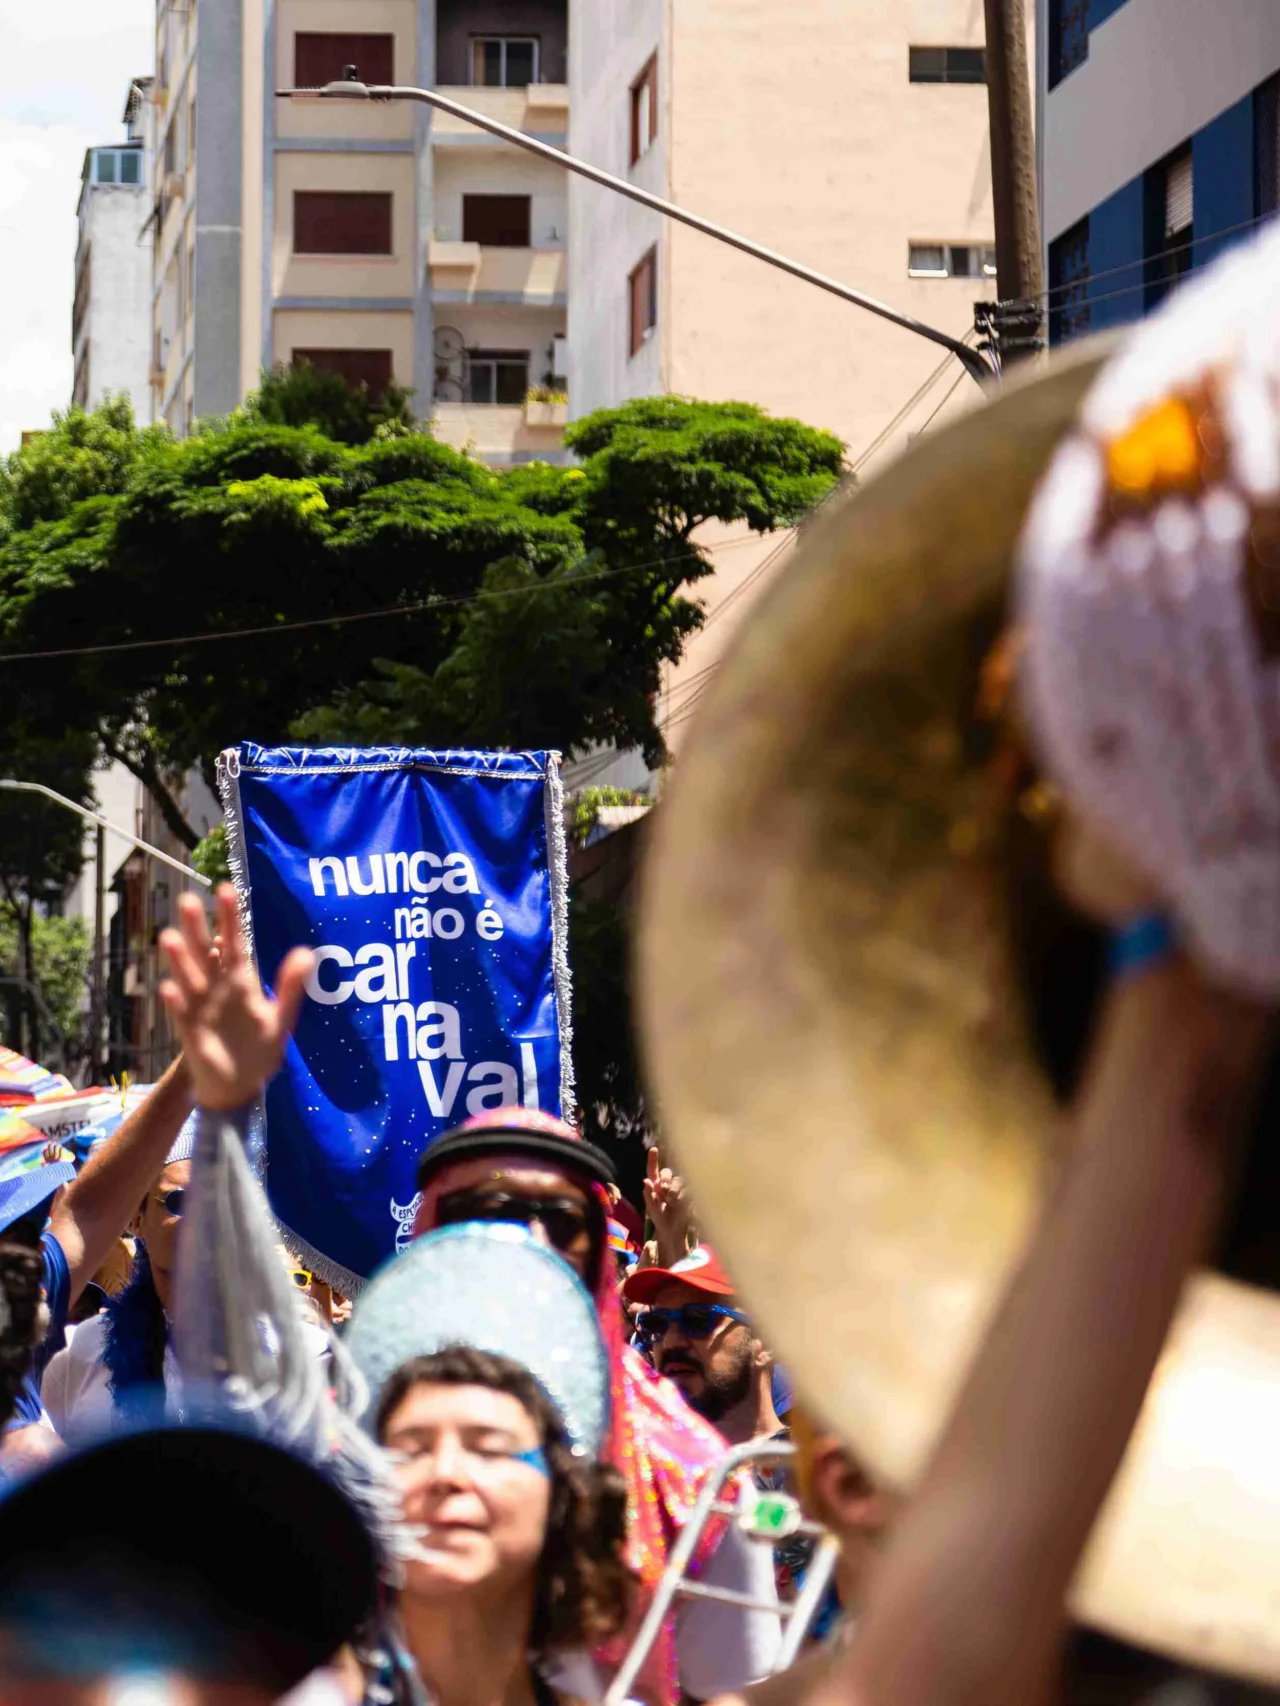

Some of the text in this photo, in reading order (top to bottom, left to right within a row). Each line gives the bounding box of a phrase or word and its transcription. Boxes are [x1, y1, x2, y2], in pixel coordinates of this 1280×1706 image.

[309, 850, 482, 897] nunca
[394, 896, 504, 941] não é
[302, 940, 417, 1005] car
[383, 1000, 465, 1062] na
[416, 1042, 540, 1118] val
